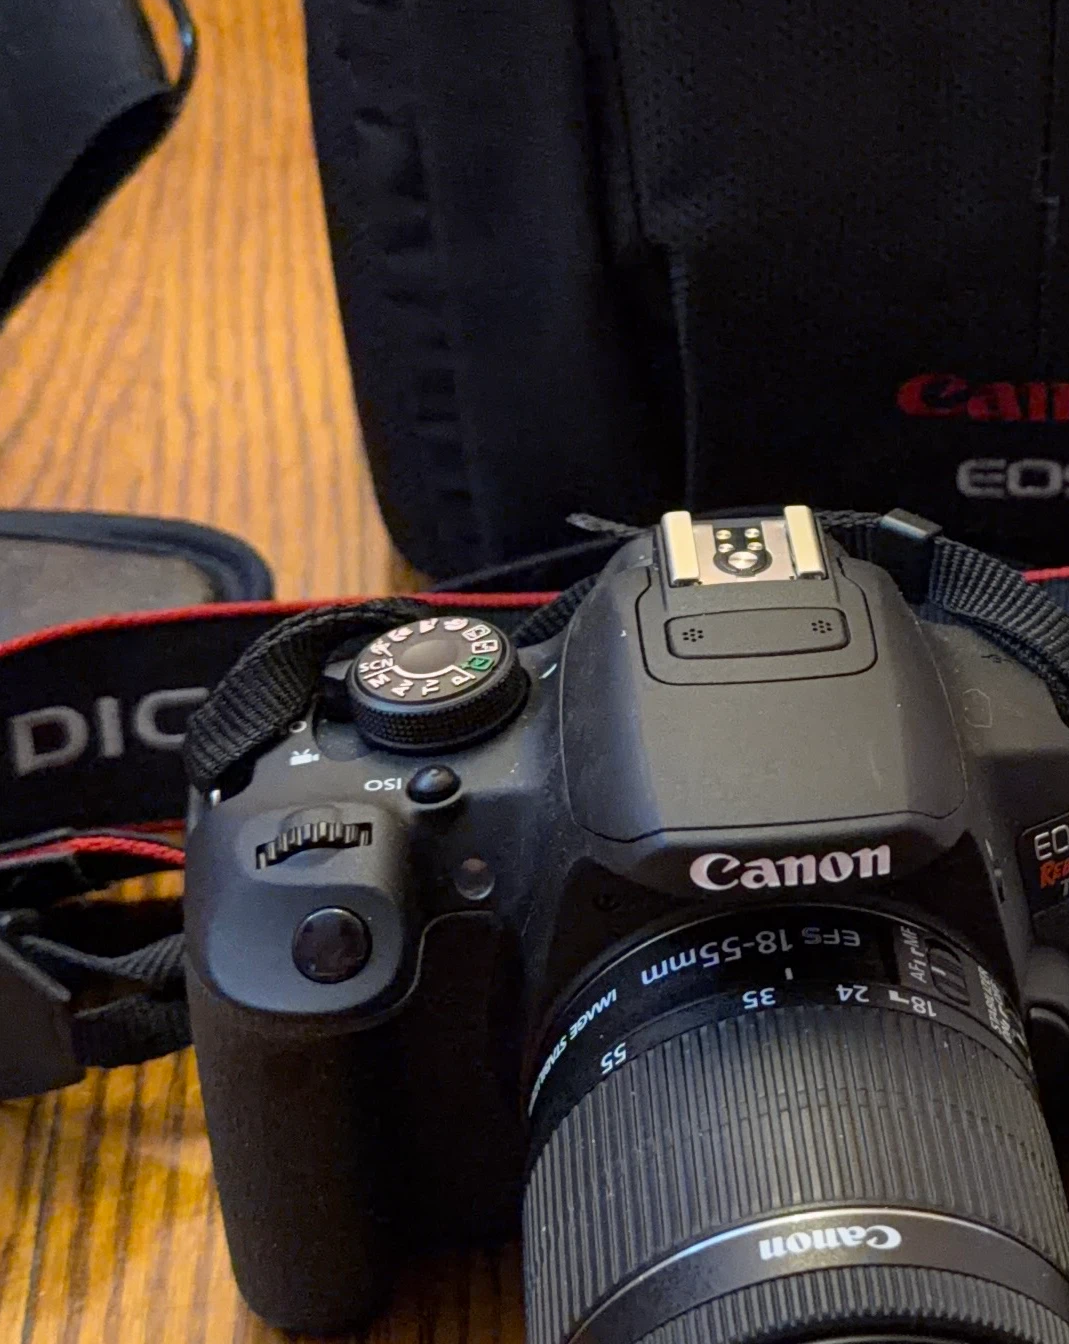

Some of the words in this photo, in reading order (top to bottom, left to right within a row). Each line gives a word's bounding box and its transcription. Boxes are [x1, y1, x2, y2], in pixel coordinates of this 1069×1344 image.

[359, 657, 394, 674] SCN
[367, 673, 391, 690] M
[363, 777, 403, 792] ISO
[689, 844, 891, 891] Canon
[900, 925, 920, 948] MF
[640, 928, 794, 986] 18-55mm
[908, 962, 928, 984] AF
[741, 987, 776, 1010] 35
[835, 983, 870, 1003] 24
[569, 988, 618, 1041] IMAGE
[910, 995, 937, 1018] 18
[600, 1042, 627, 1075] 55
[758, 1224, 902, 1261] Canon
